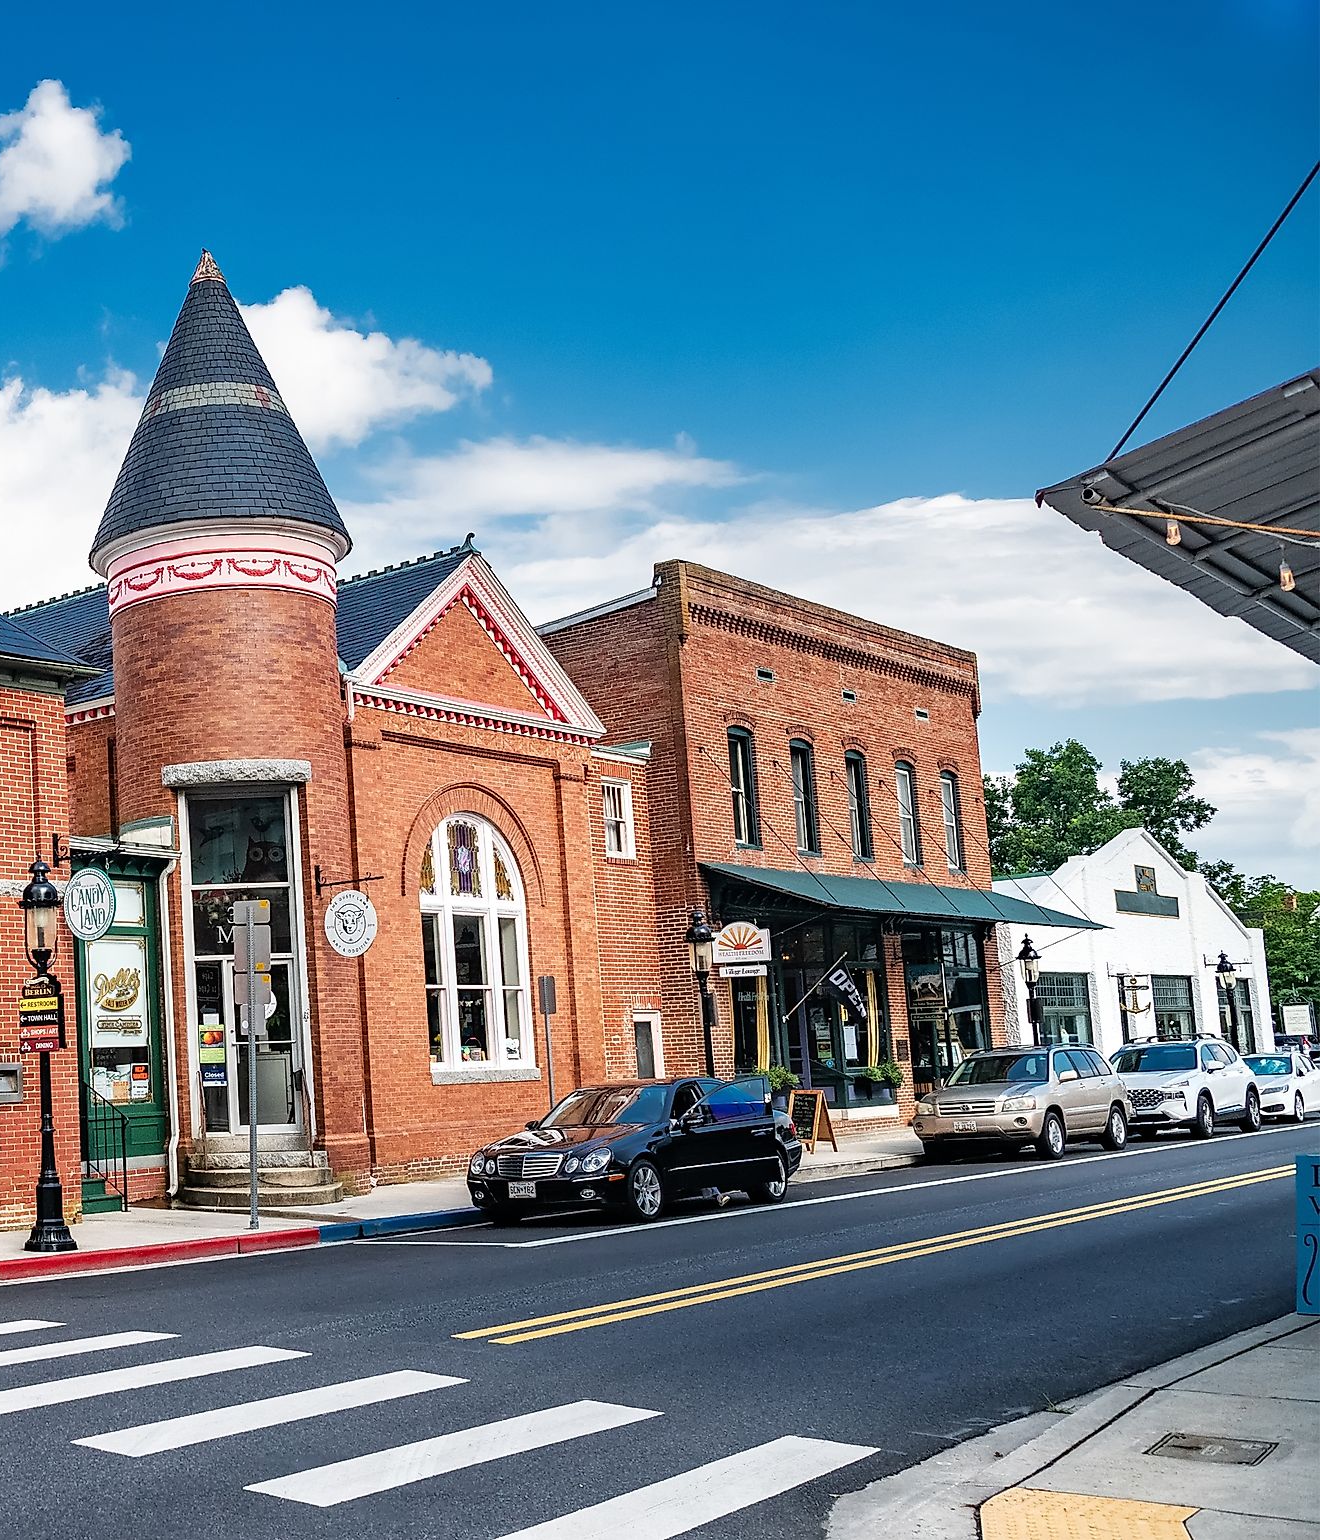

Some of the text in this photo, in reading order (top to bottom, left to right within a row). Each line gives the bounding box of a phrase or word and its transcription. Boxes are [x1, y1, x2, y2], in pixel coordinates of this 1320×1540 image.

[70, 882, 106, 913] CANDY
[80, 905, 105, 930] LAND
[24, 987, 52, 997] BERLIN
[27, 1000, 57, 1008] RESTROOMS
[27, 1013, 58, 1022] TOWN HALL
[35, 1042, 54, 1050] DINING
